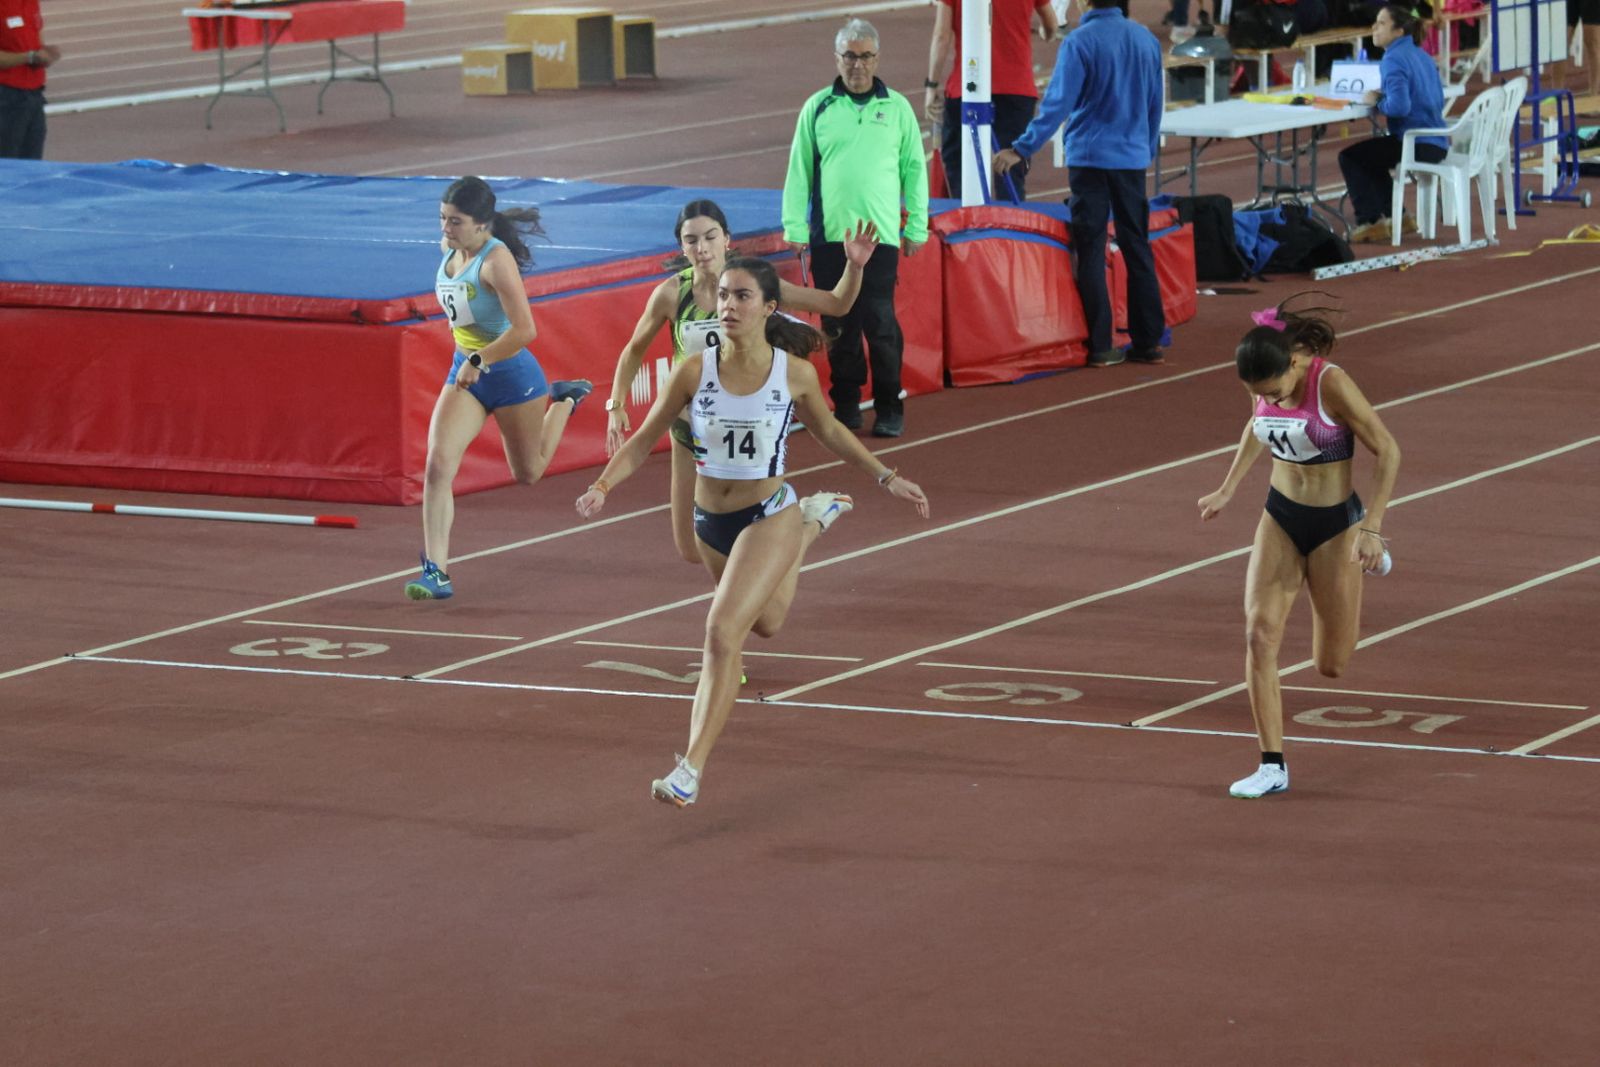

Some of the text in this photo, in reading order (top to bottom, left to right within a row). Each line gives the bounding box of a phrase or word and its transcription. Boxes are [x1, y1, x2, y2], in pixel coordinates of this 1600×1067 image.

[723, 430, 756, 459] 14
[1268, 430, 1297, 456] 11
[229, 637, 390, 659] 8
[924, 682, 1083, 705] 6
[1292, 706, 1467, 734] 5
